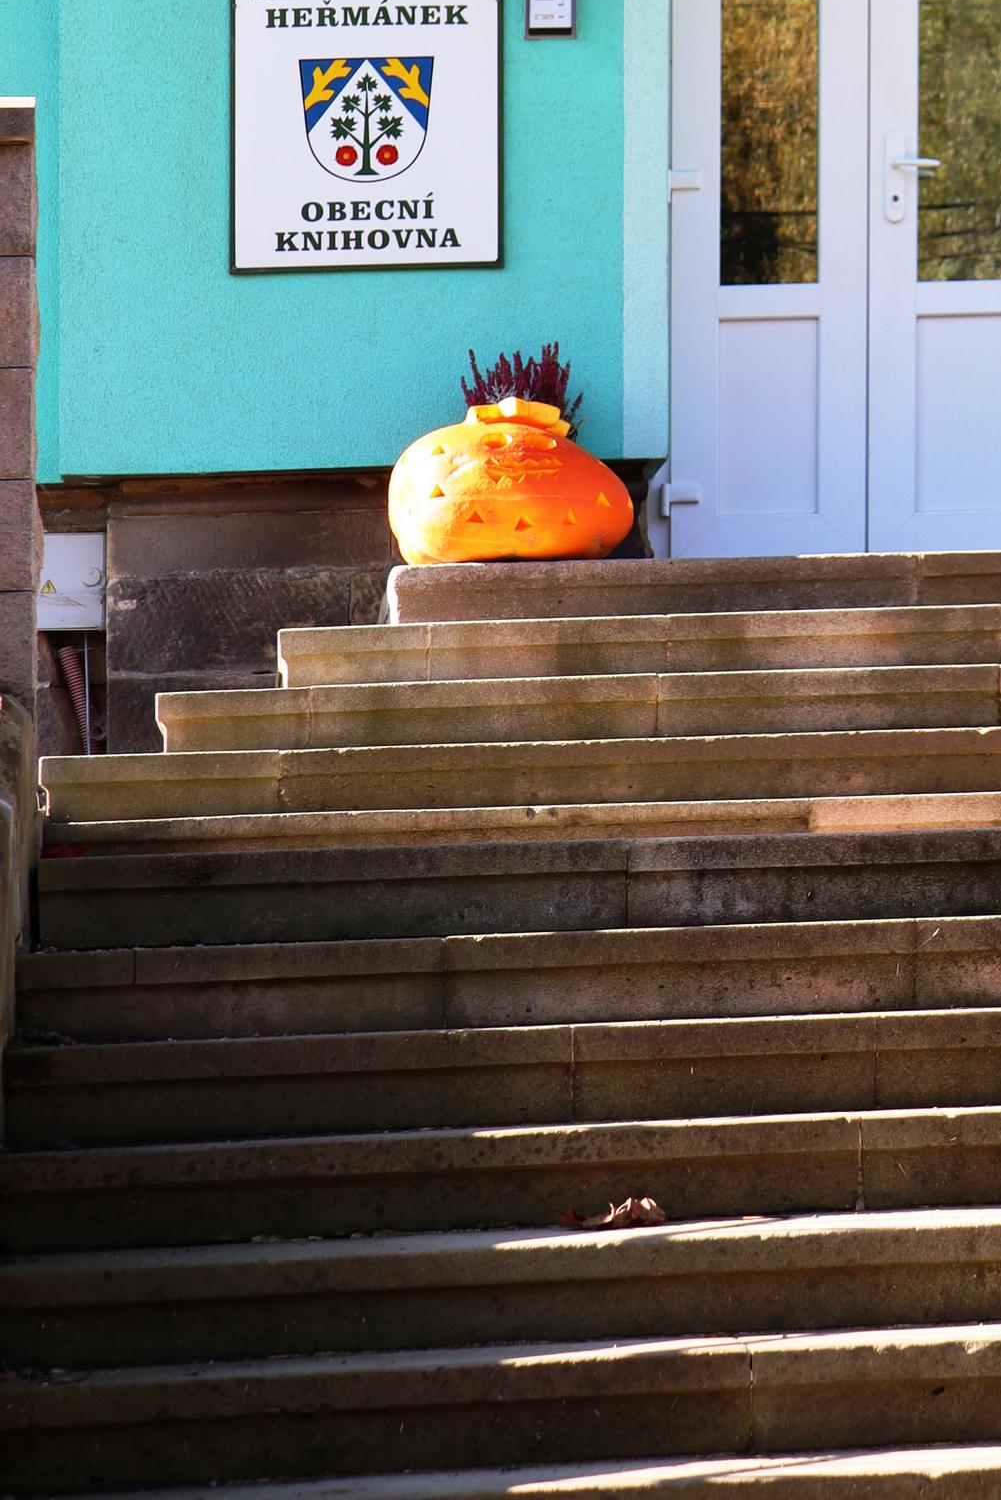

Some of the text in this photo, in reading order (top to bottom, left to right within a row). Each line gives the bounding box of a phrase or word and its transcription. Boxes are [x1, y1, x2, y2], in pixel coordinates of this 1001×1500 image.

[265, 0, 469, 28] HEŘMÁNEK
[301, 192, 434, 222] OBECNÍ
[275, 228, 462, 252] KNIHOVNA
